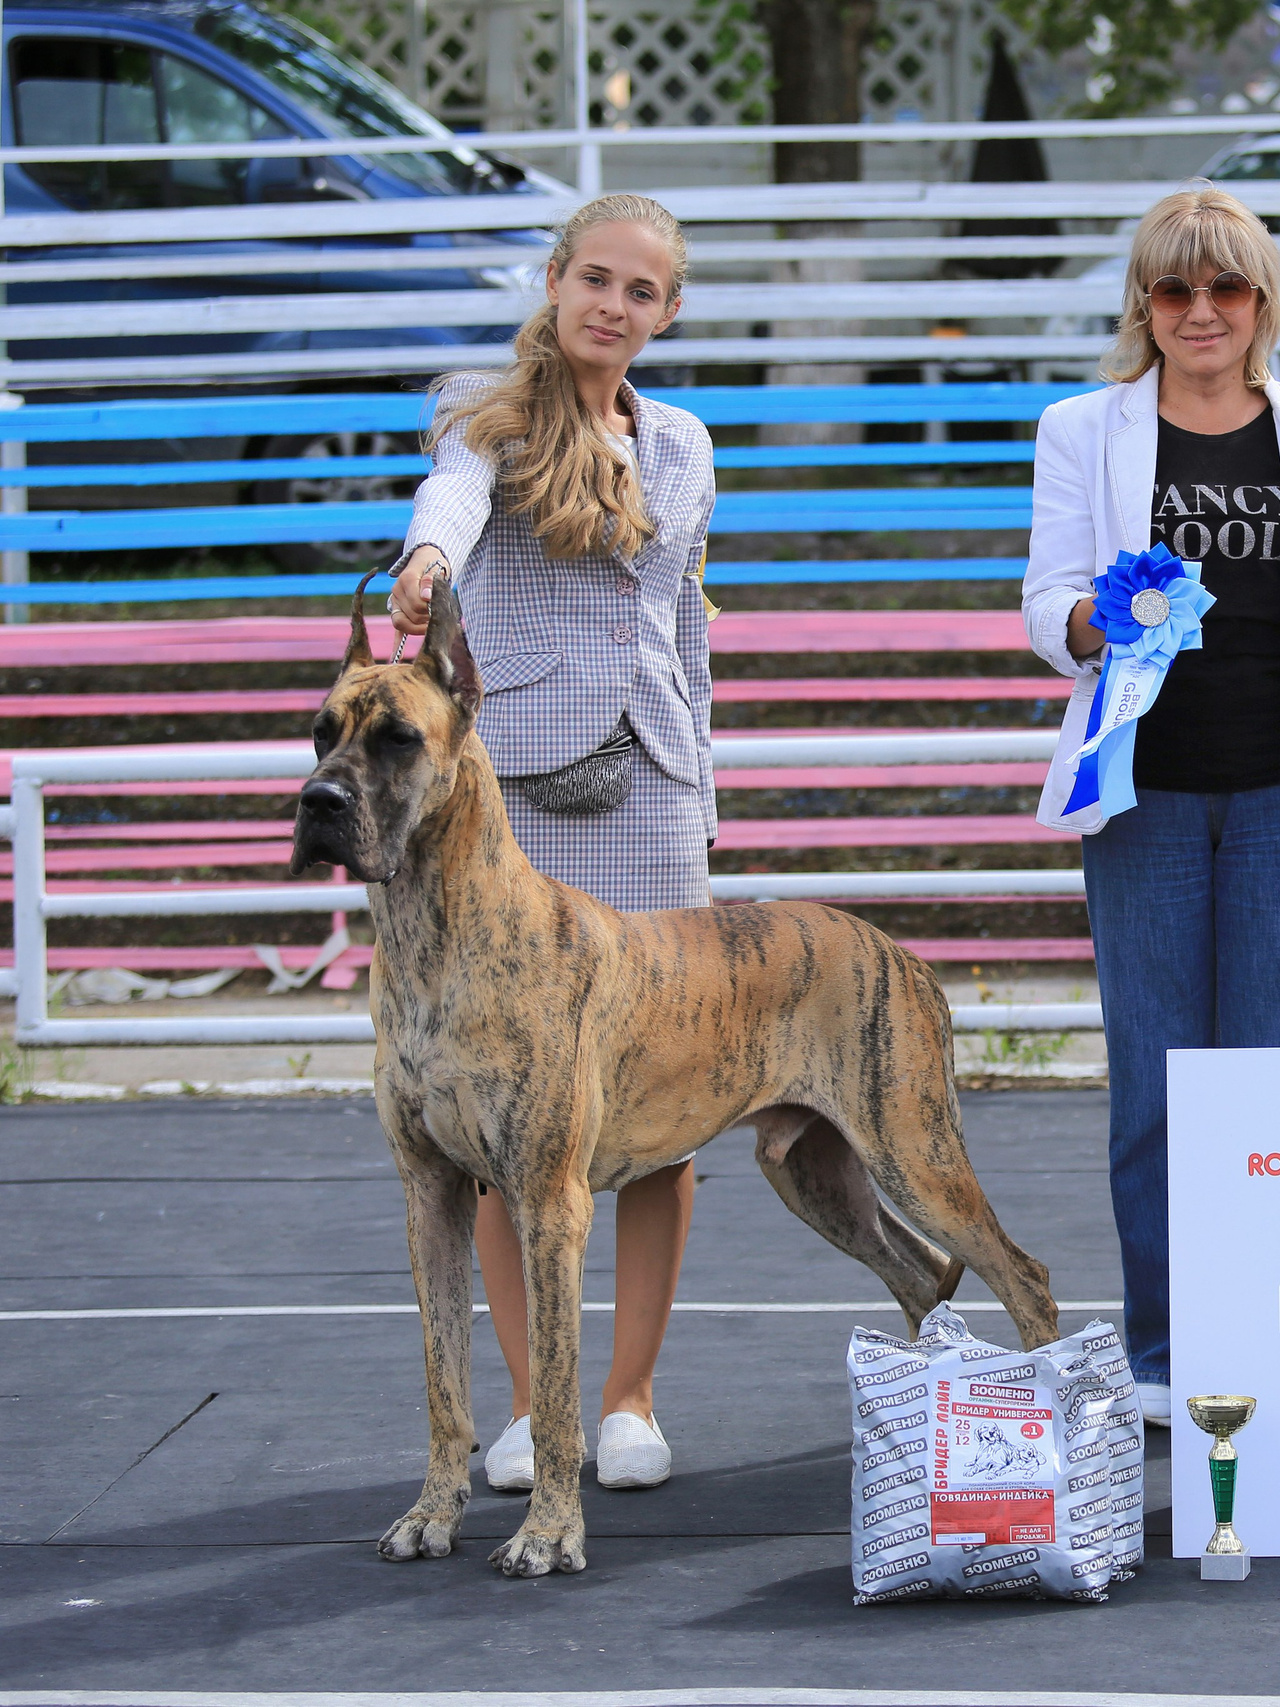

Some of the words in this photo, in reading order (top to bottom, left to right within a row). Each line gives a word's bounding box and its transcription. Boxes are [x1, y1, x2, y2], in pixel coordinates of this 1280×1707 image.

[856, 1360, 927, 1389] ЗООМЕНЮ
[859, 1386, 926, 1416] ЗООМЕНЮ
[934, 1380, 951, 1424] ЛАЙН
[971, 1386, 1033, 1400] ЗООМЕНЮ
[955, 1405, 990, 1416] БРИДЕР
[992, 1408, 1048, 1418] УНИВЕРСАЛ
[955, 1418, 971, 1430] 25
[862, 1413, 926, 1443] ЗООМЕНЮ
[955, 1436, 970, 1446] 12
[863, 1440, 926, 1471] ЗООМЕНЮ
[934, 1428, 950, 1490] БРИДЕР
[1108, 1438, 1139, 1456] ОМЕНЮ
[863, 1467, 925, 1499] ЗООМЕНЮ
[935, 1491, 1050, 1503] ГОВЯДИНА+ИНДЕЙКА
[863, 1495, 926, 1527] ЗООМЕНЮ
[863, 1525, 927, 1556] ЗООМЕНЮ
[1072, 1524, 1113, 1548] ЗООМЕН
[863, 1554, 928, 1583] ЗООМЕНЮ
[964, 1549, 1037, 1576] ЗООМЕНЮ
